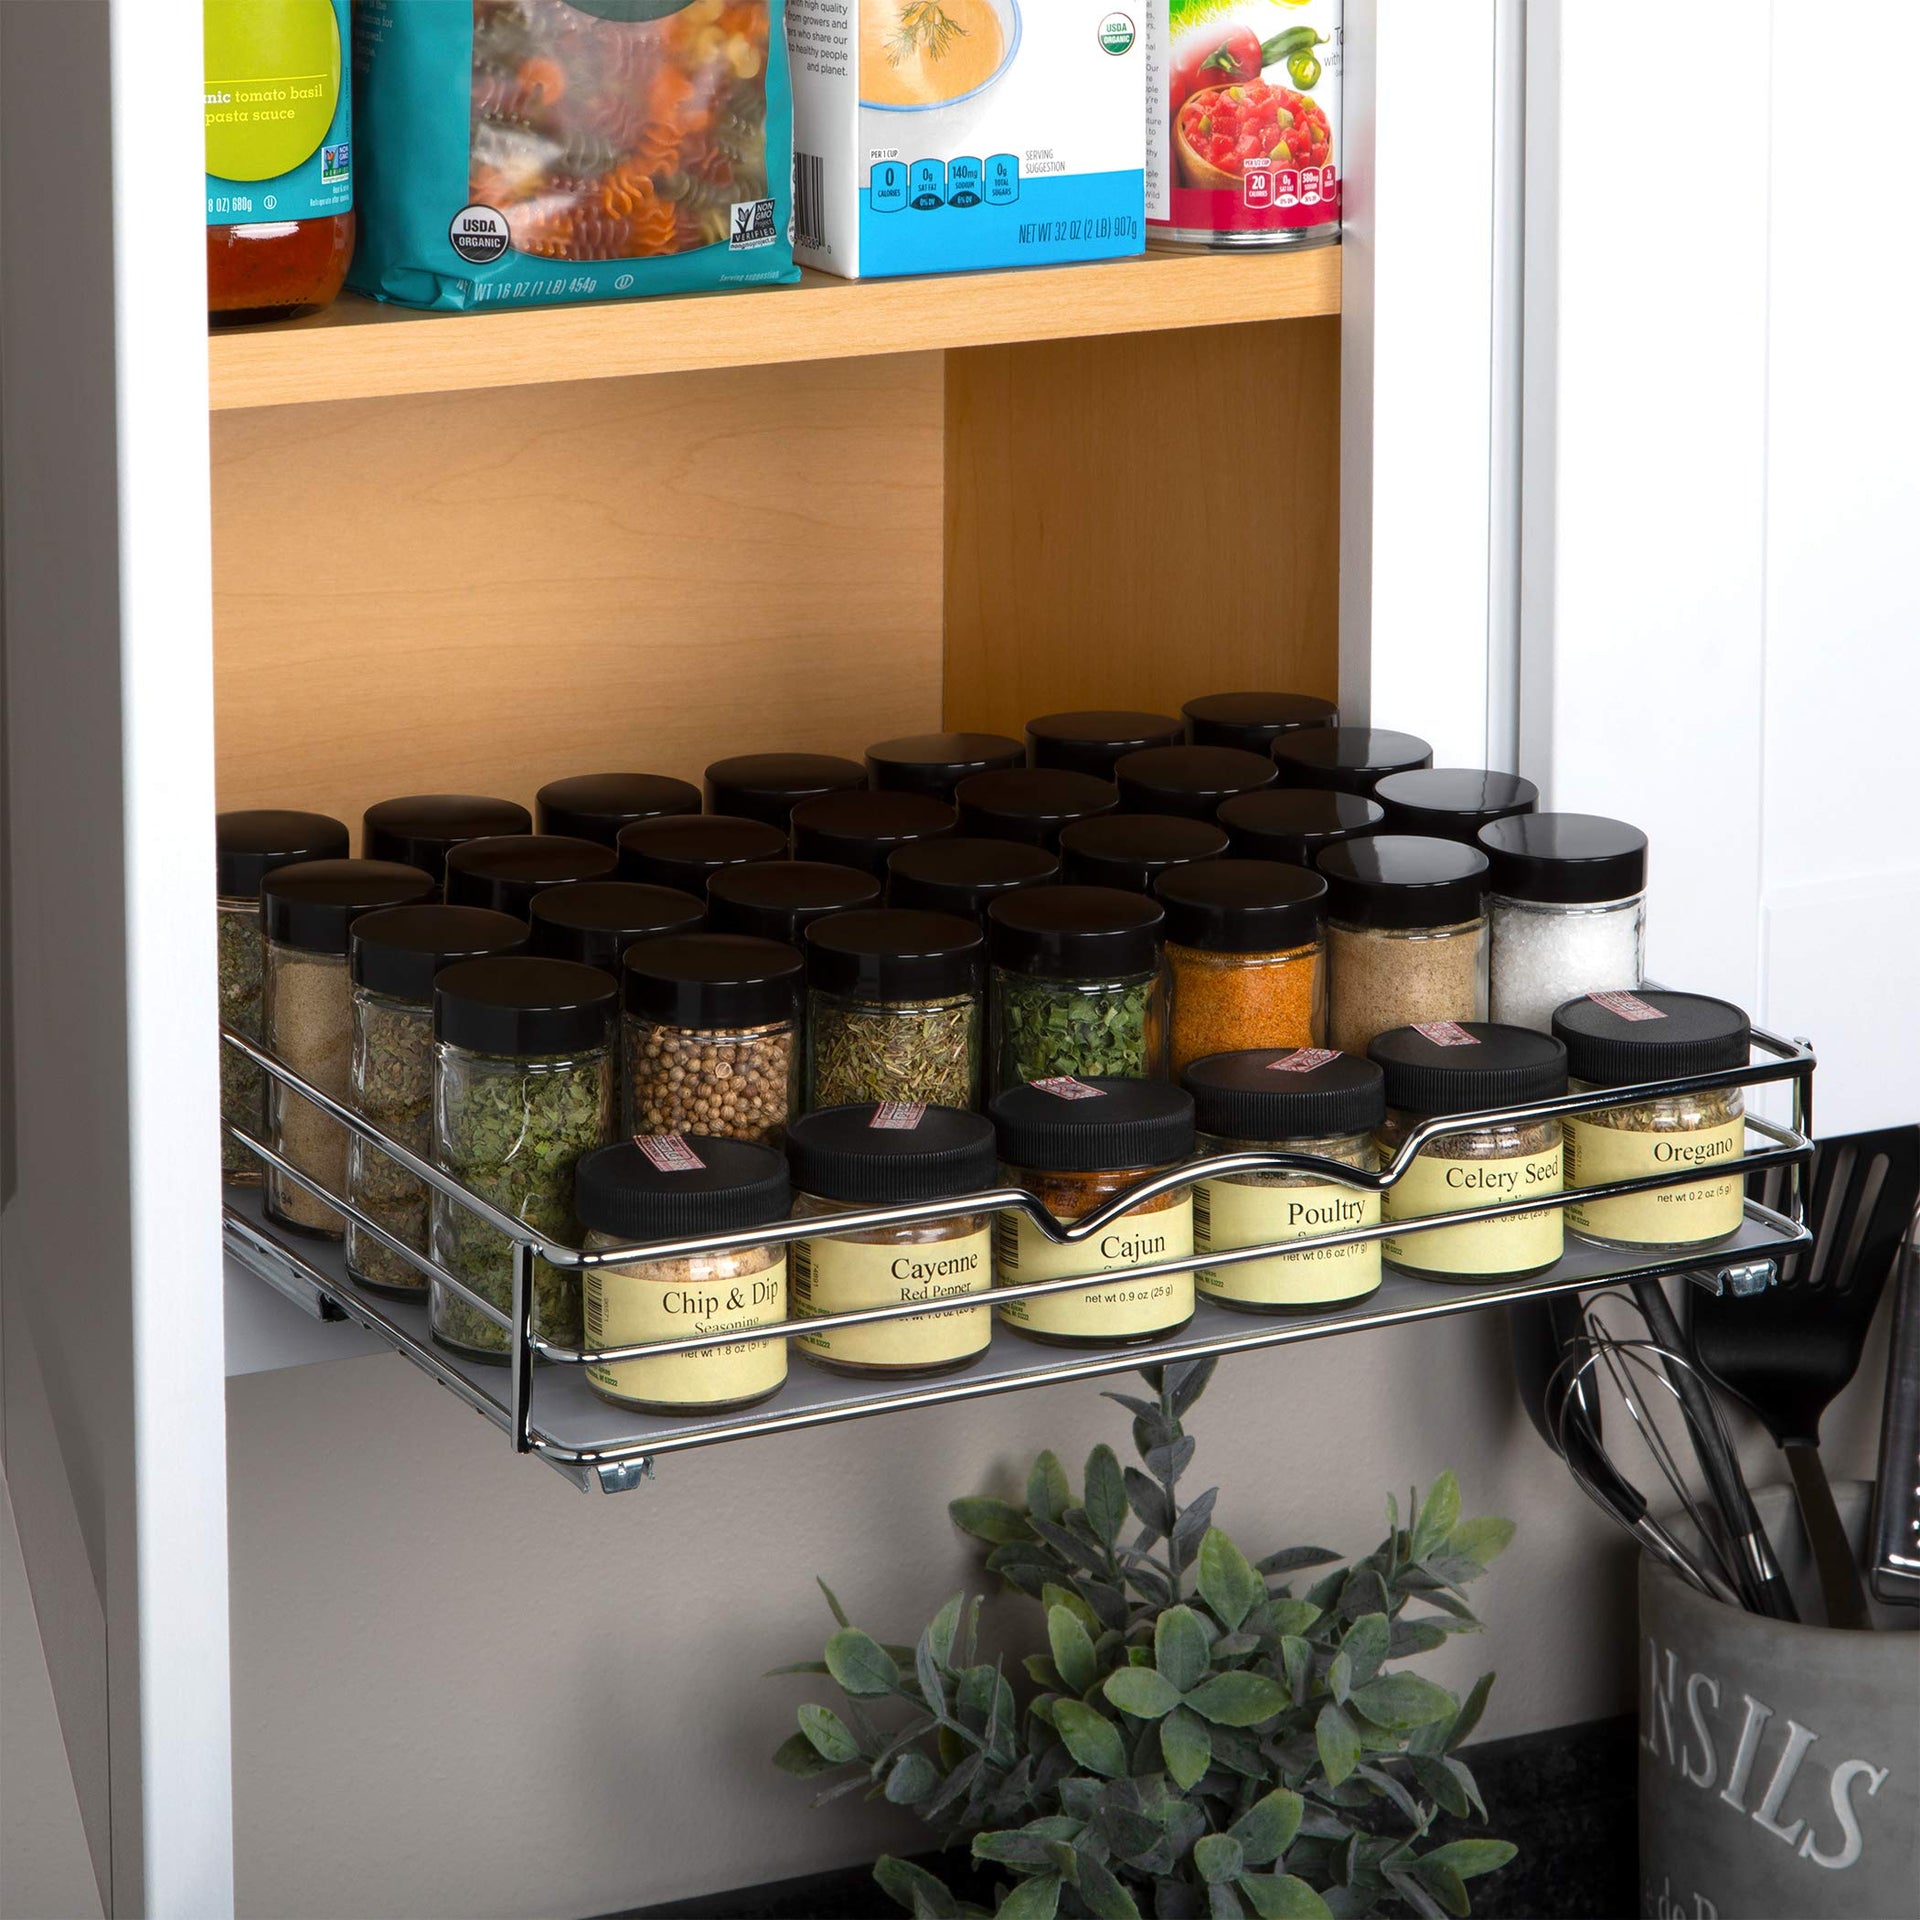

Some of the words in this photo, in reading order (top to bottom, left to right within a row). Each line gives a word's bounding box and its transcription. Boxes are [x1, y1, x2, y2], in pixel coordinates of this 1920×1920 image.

[821, 3, 848, 16] quality
[803, 16, 830, 27] growers
[832, 20, 848, 30] and
[1107, 23, 1127, 33] USDA
[812, 33, 832, 43] share
[833, 36, 848, 45] our
[1103, 35, 1130, 44] ORGANIC
[796, 43, 819, 58] healthy
[820, 50, 848, 61] people
[806, 63, 820, 73] and
[821, 64, 848, 77] planet.
[235, 88, 287, 103] tomato
[290, 84, 323, 99] basil
[205, 110, 248, 127] pasta
[252, 109, 296, 121] sauce
[871, 150, 883, 159] PER
[888, 150, 898, 158] CUP
[1026, 149, 1054, 161] SERVING
[922, 168, 933, 181] 0g
[952, 165, 978, 179] 140mg
[997, 162, 1007, 176] 0g
[1026, 161, 1066, 174] SUGGESTION
[885, 168, 894, 186] 0
[994, 179, 1009, 187] TOTAL
[1252, 175, 1265, 189] 20
[918, 184, 927, 192] SAT
[955, 181, 975, 189] SODIUM
[992, 188, 1012, 196] SUGARS
[878, 189, 901, 198] CALORIES
[216, 197, 230, 213] OZ)
[232, 196, 253, 212] 680g
[757, 202, 773, 212] NON
[756, 211, 772, 220] GMO
[463, 219, 496, 232] USDA
[1019, 223, 1037, 244] NET
[1038, 222, 1053, 242] WT
[1055, 221, 1067, 241] 32
[1070, 220, 1082, 240] OZ
[1084, 218, 1093, 242] (2
[1096, 217, 1111, 240] LB)
[1114, 215, 1137, 240] 907g
[459, 236, 500, 248] ORGANIC
[735, 228, 776, 242] VERIFIED
[474, 283, 494, 301] WT
[497, 283, 511, 302] 16
[513, 281, 530, 298] OZ
[531, 281, 543, 297] (1
[546, 279, 567, 296] LB)
[569, 276, 598, 294] 454g
[1654, 1138, 1733, 1165] Oregano
[1446, 1167, 1518, 1192] Celery
[1525, 1155, 1559, 1184] Seed
[1657, 1194, 1673, 1203] net
[1675, 1193, 1686, 1202] wt
[1705, 1190, 1714, 1198] oz
[1716, 1185, 1724, 1197] (5
[1725, 1184, 1732, 1195] g)
[1288, 1198, 1366, 1225] Poultry
[1101, 1233, 1165, 1263] Cajun
[1283, 1252, 1300, 1262] net
[1303, 1252, 1315, 1261] wt
[1317, 1249, 1332, 1259] 0.6
[1335, 1248, 1345, 1257] oz
[1347, 1243, 1359, 1257] (17
[1361, 1242, 1368, 1254] g)
[891, 1254, 978, 1284] Cayenne
[663, 1291, 719, 1319] Chip
[726, 1287, 746, 1310] &
[752, 1278, 779, 1305] Dip
[900, 1286, 928, 1301] Red
[1085, 1294, 1101, 1303] net
[1104, 1293, 1117, 1303] wt
[1119, 1291, 1135, 1302] 0.9
[1138, 1291, 1149, 1300] oz
[1151, 1286, 1164, 1299] (25
[1166, 1283, 1173, 1297] g)
[681, 1349, 697, 1358] net
[701, 1348, 714, 1358] wt
[717, 1346, 732, 1357] 1.8
[734, 1344, 746, 1354] oz
[1643, 1638, 1889, 1869] NSILS
